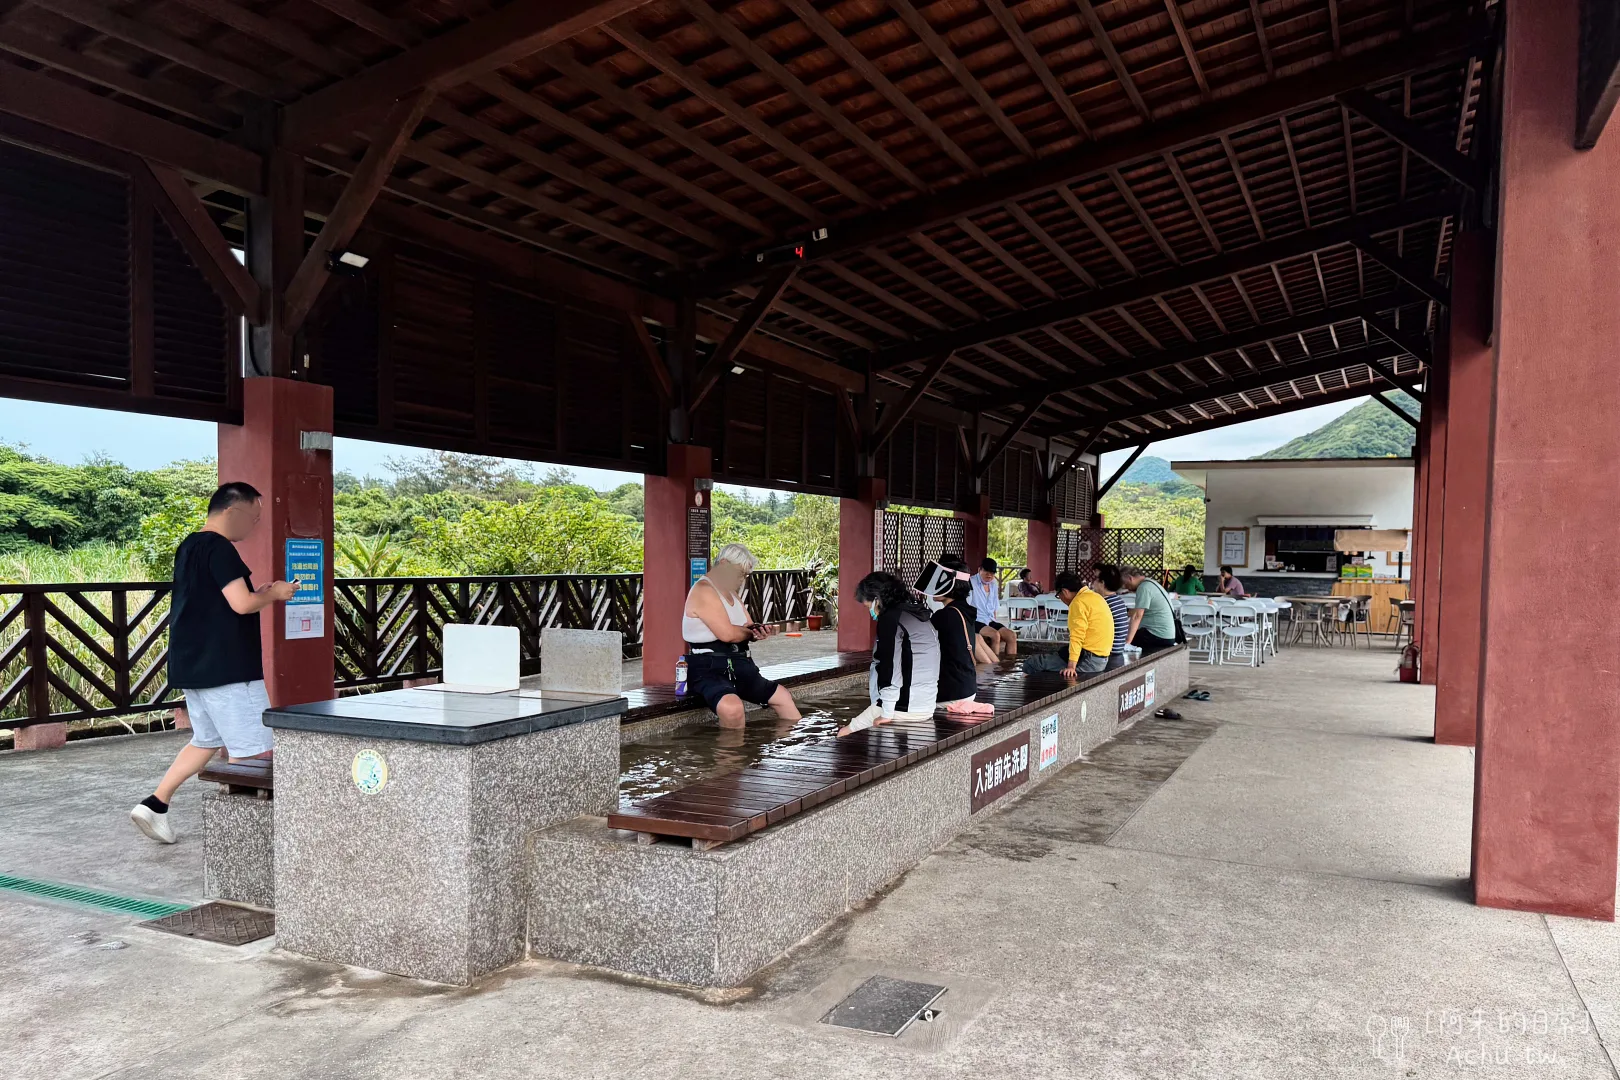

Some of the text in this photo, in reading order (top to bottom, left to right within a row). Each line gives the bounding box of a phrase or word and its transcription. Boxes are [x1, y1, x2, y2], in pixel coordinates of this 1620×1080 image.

[974, 744, 1028, 797] 入池前先洗腳
